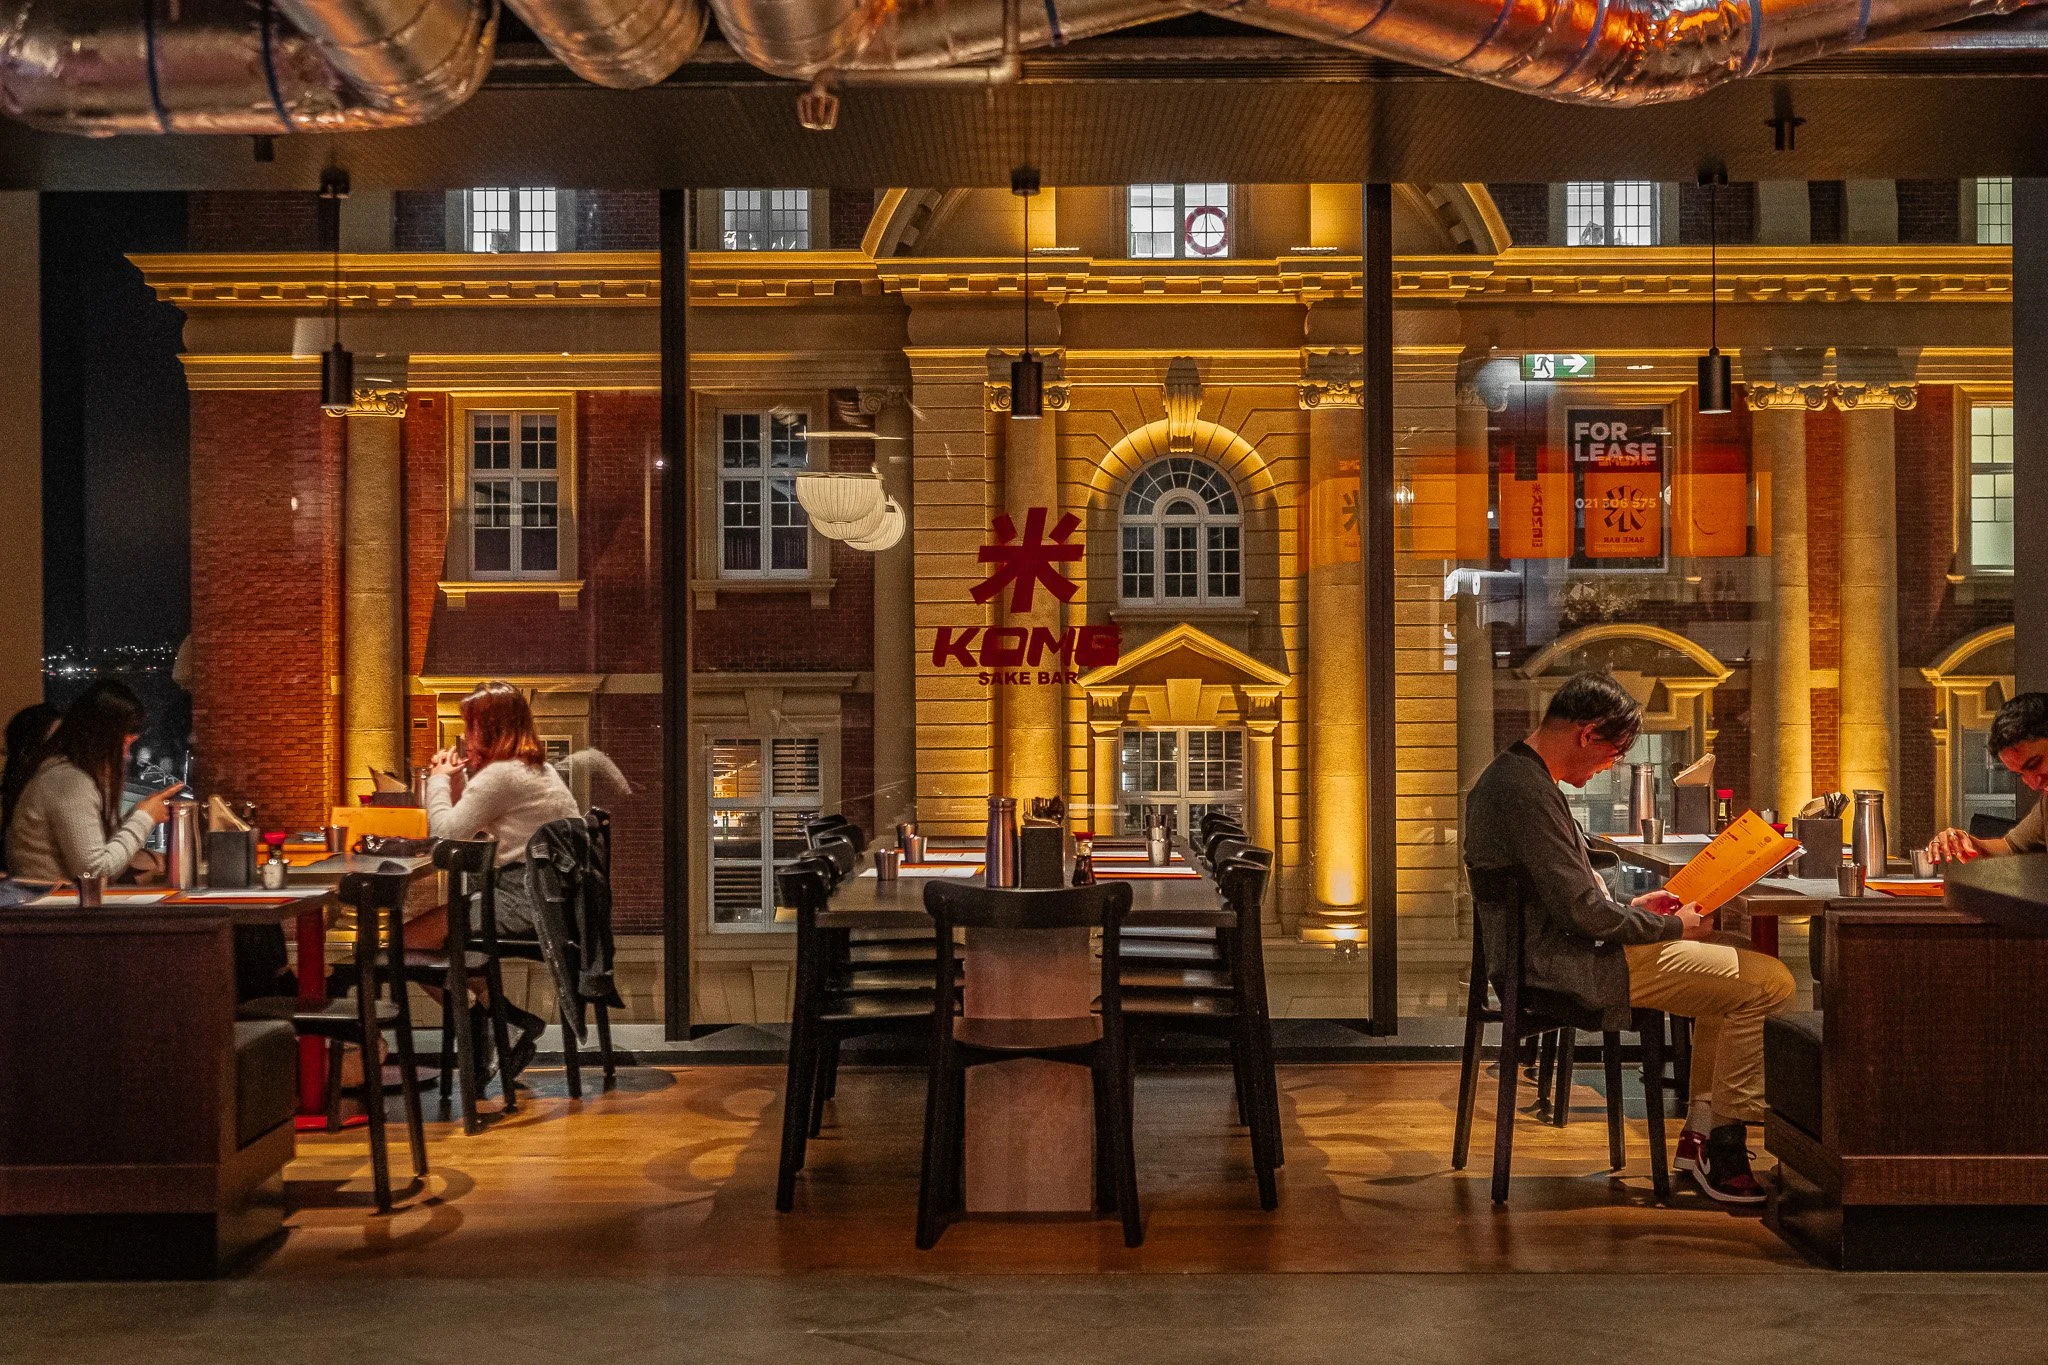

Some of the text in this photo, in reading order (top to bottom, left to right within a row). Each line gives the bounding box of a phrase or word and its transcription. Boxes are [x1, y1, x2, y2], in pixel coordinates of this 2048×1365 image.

[1574, 422, 1628, 441] FOR
[1574, 442, 1657, 462] LEASE
[1575, 497, 1599, 509] 021
[1632, 498, 1657, 509] 575
[978, 671, 1079, 686] SAKE BAR
